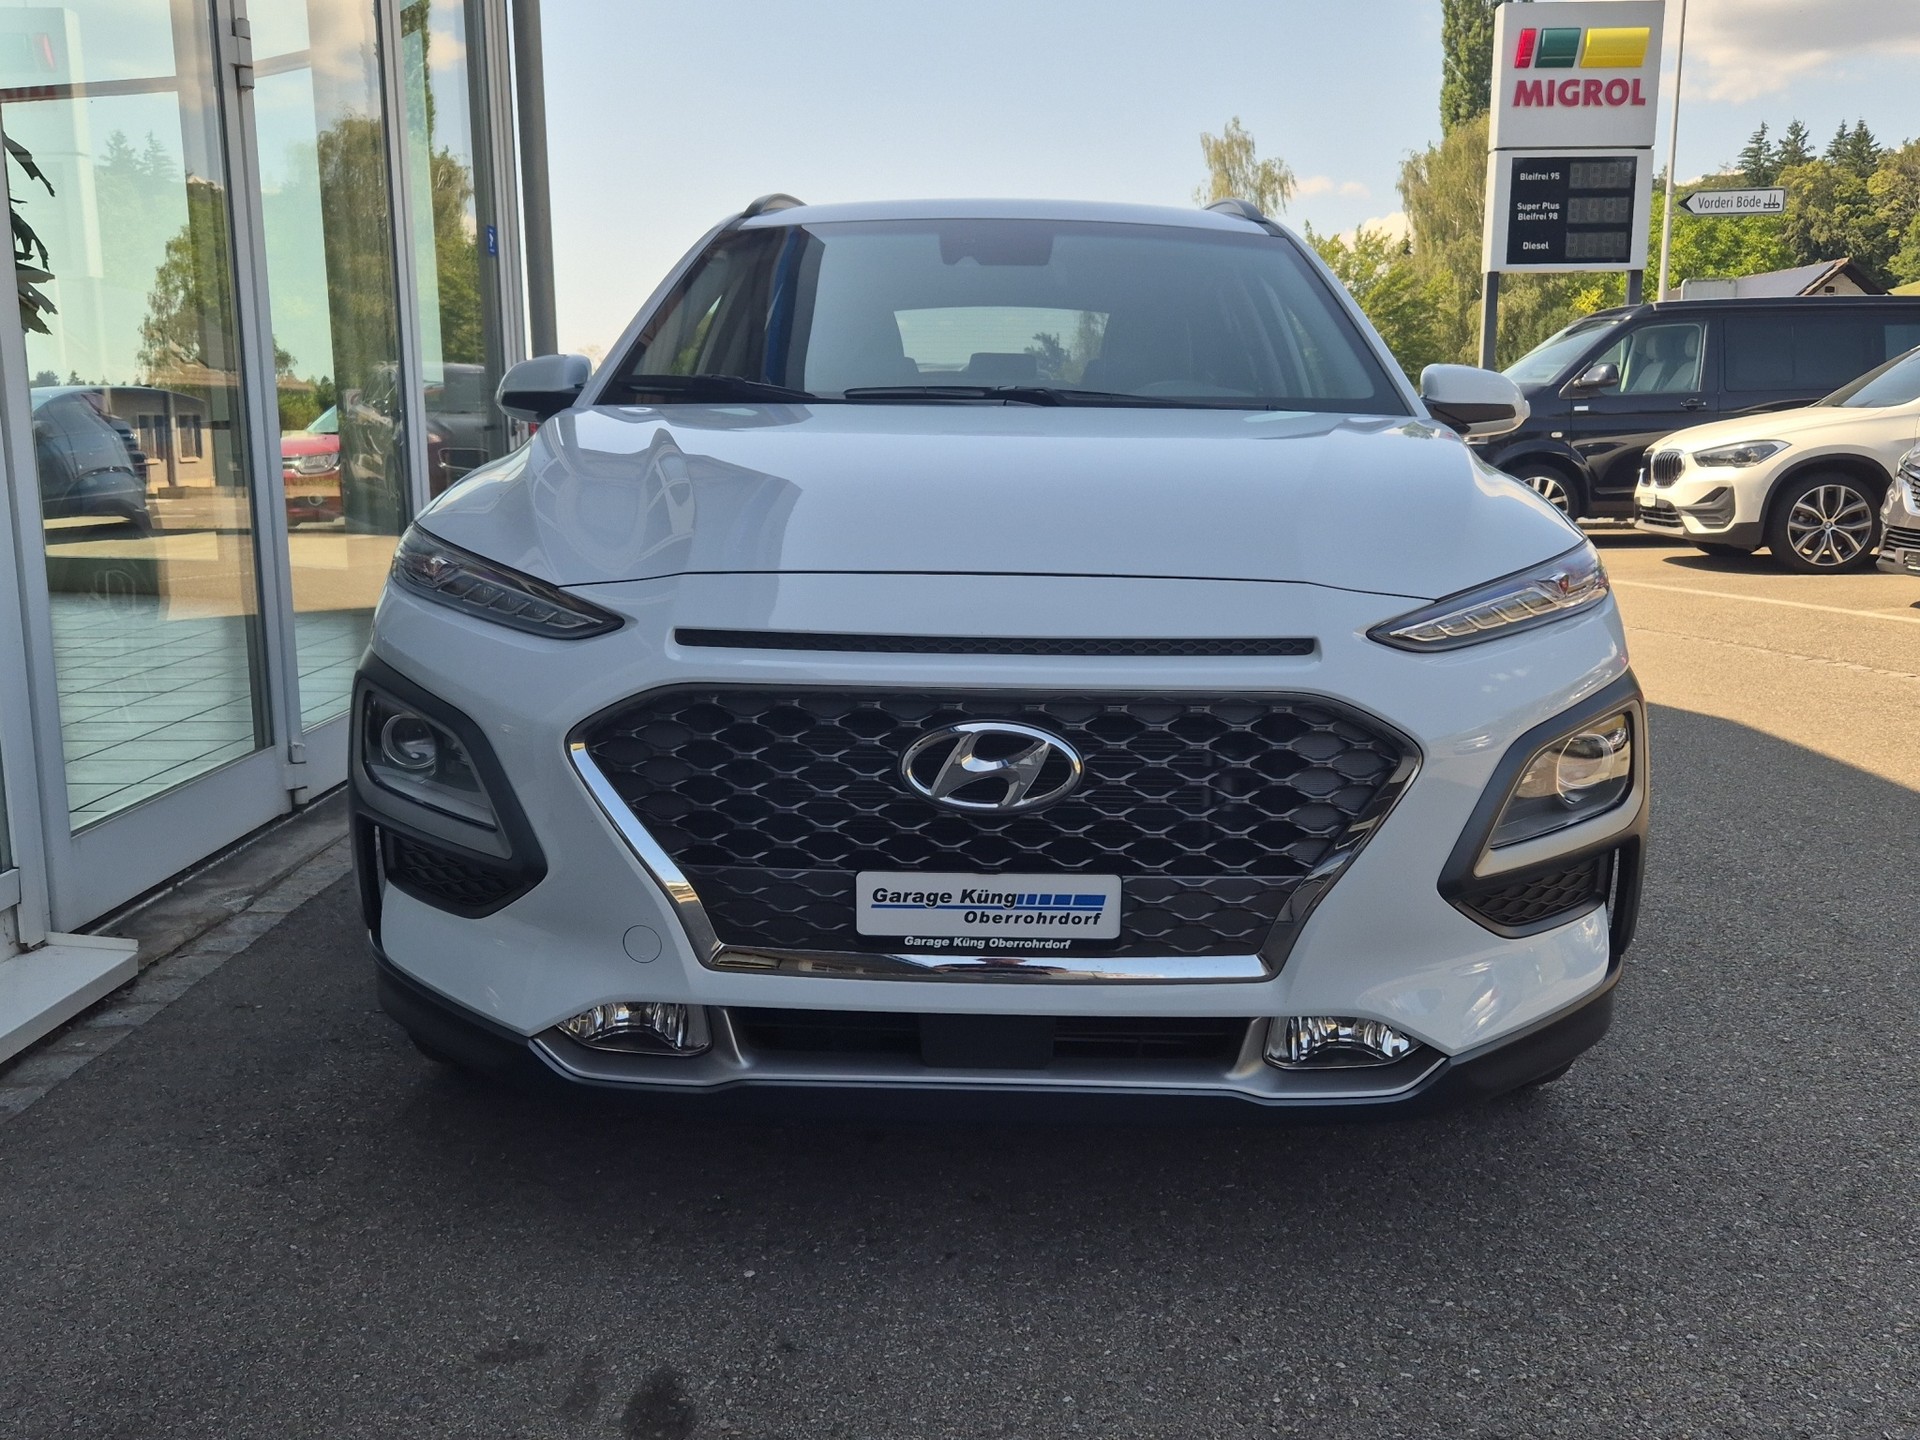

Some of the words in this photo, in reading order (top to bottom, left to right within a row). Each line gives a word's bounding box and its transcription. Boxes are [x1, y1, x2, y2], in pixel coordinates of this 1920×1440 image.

[1513, 78, 1646, 107] MIGROL
[1520, 172, 1549, 181] Bleifrei
[1550, 172, 1560, 180] 95
[1517, 202, 1541, 211] Super
[1542, 202, 1560, 210] Plus
[1698, 196, 1733, 209] Vorderi
[1736, 195, 1762, 208] Böde
[1518, 213, 1547, 221] Bleifrei
[1548, 212, 1558, 220] 98
[1522, 241, 1549, 250] Diesel
[872, 887, 953, 907] Garage
[960, 888, 1017, 909] Küng
[964, 911, 1102, 925] Oberrohrdorf
[904, 936, 950, 948] Garage
[953, 937, 985, 949] Küng
[989, 938, 1072, 949] Oberrohrdorf
